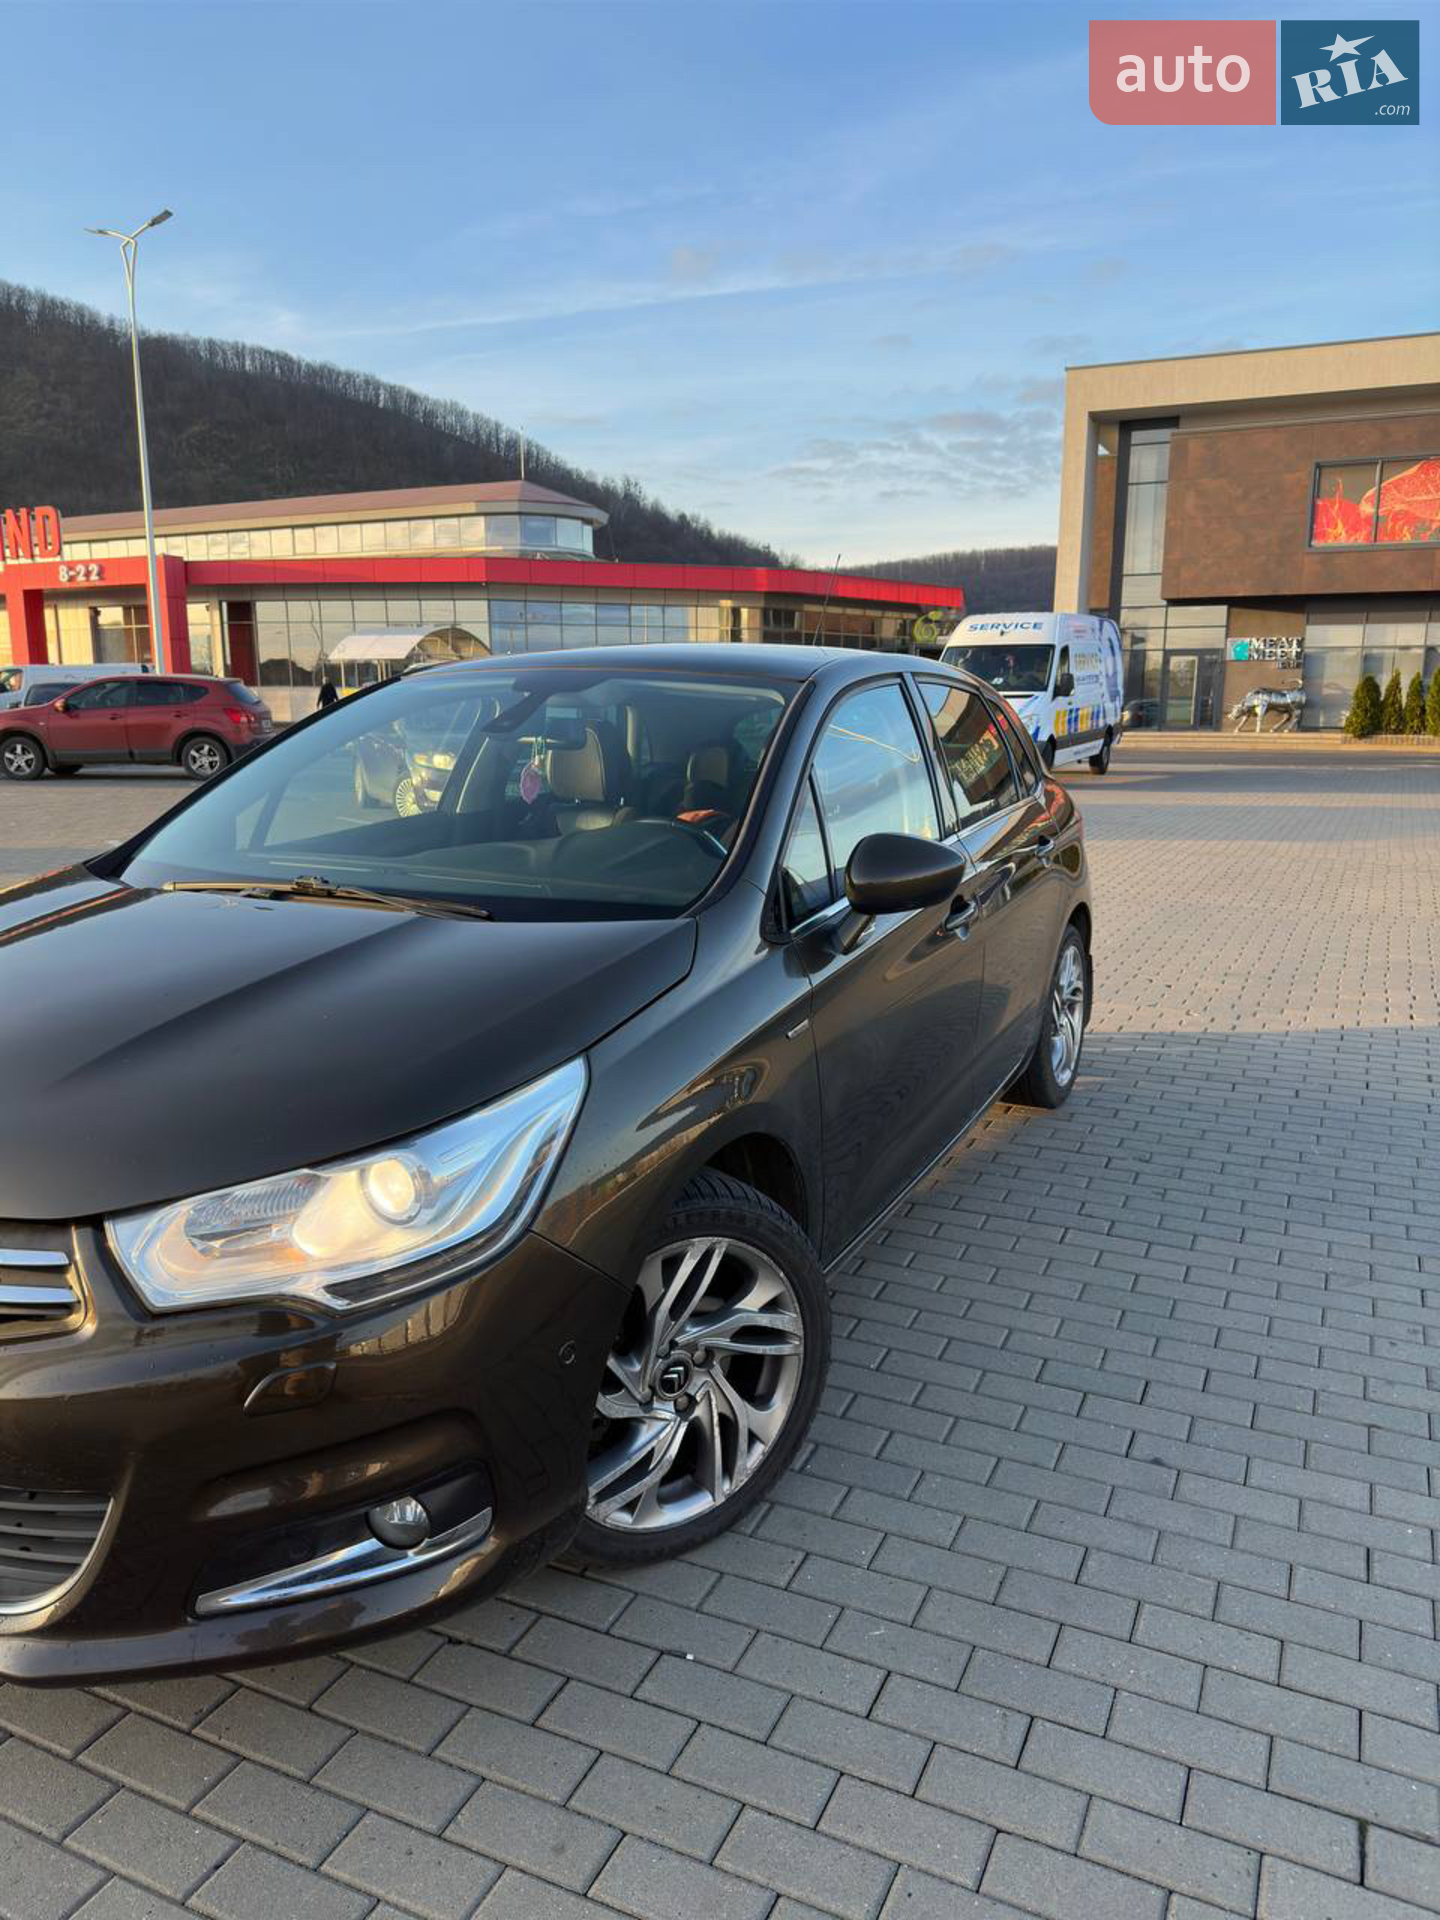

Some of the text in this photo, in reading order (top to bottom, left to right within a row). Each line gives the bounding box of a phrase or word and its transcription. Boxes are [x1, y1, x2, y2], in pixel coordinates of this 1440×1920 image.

[0, 506, 61, 560] ND
[59, 564, 100, 582] 8-22
[968, 622, 1044, 632] SERVICE
[1249, 636, 1302, 648] MEAT
[1249, 648, 1302, 660] MEET
